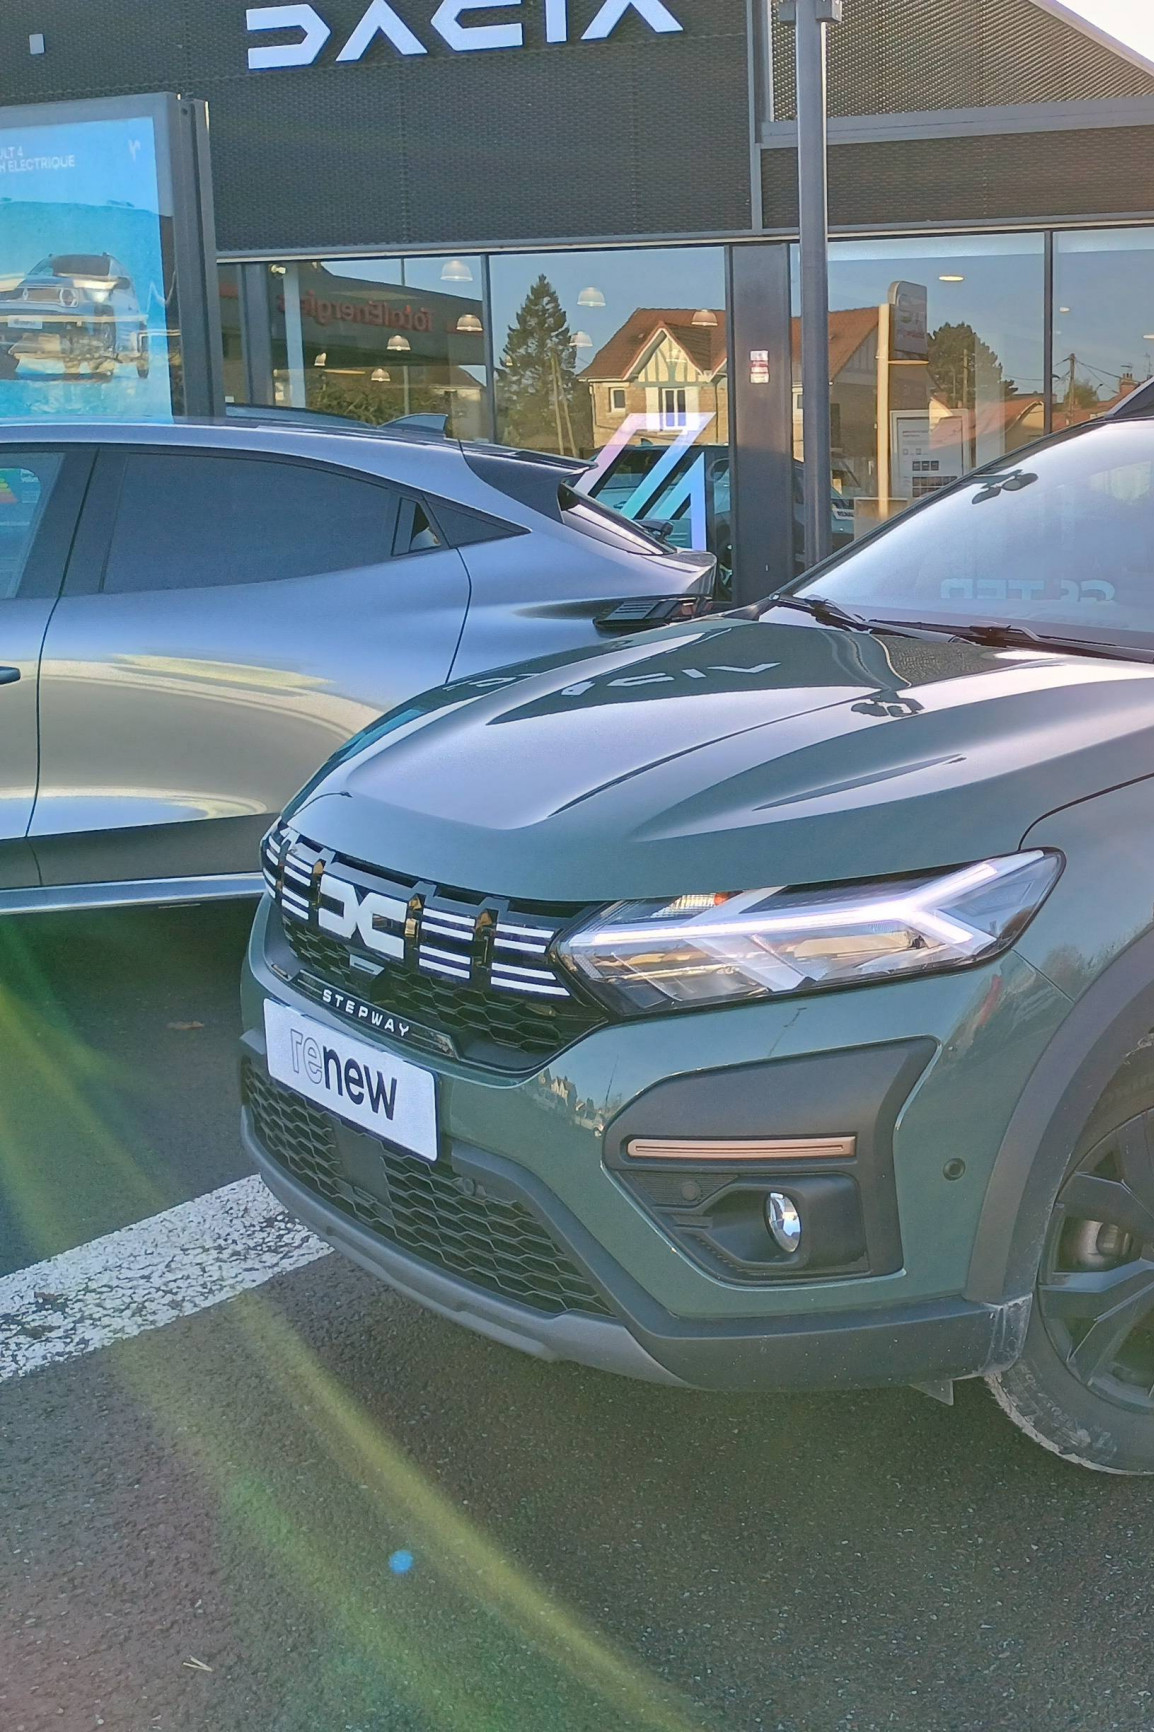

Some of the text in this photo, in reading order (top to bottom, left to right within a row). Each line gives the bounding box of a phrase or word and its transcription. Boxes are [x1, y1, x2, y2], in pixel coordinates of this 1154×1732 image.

[246, 0, 684, 70] DACIA
[322, 989, 410, 1037] STEPWAY
[290, 1028, 398, 1121] renew
